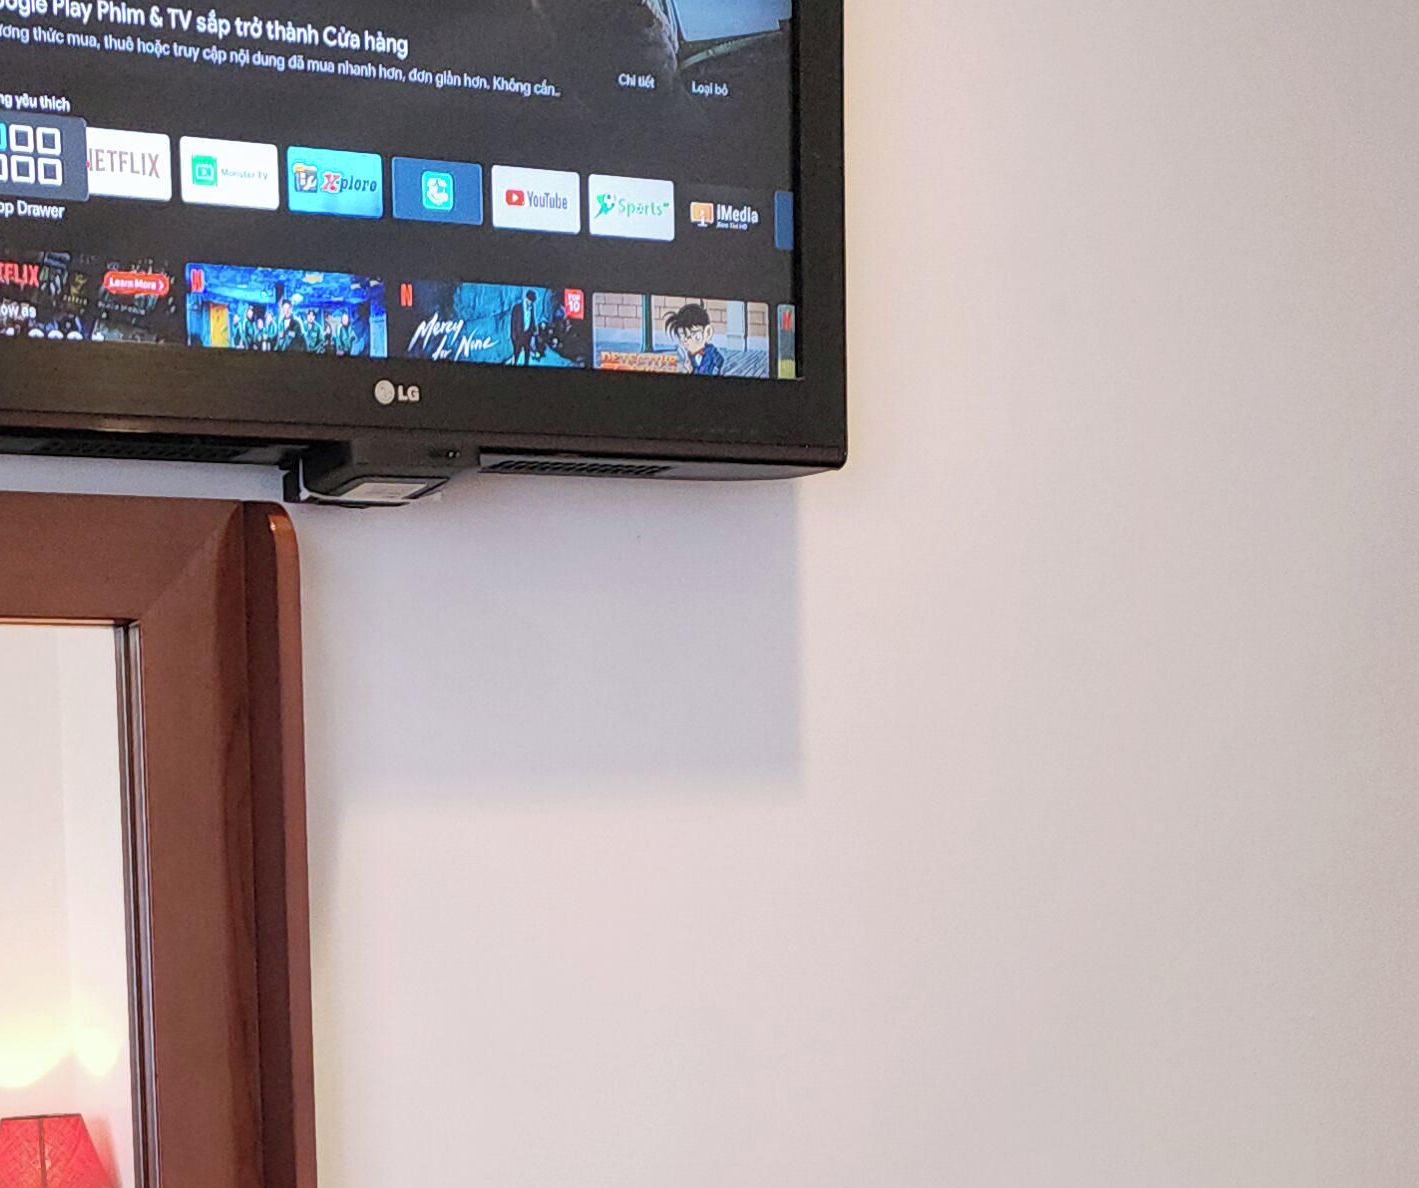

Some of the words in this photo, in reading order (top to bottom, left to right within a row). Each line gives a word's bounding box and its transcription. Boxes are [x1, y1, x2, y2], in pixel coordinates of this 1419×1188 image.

[52, 0, 93, 25] Play
[97, 0, 146, 26] Phim
[149, 5, 164, 28] &
[167, 7, 193, 31] TV
[195, 9, 231, 40] sắp
[322, 25, 361, 49] Cửa
[33, 26, 65, 44] thức
[67, 33, 101, 50] mua,
[103, 34, 134, 52] thuê
[137, 37, 171, 58] hoặc
[173, 42, 201, 62] truy
[202, 45, 227, 65] cập
[252, 50, 285, 72] dung
[288, 54, 305, 70] đã
[307, 58, 335, 73] mua
[338, 60, 377, 78] nhanh
[379, 64, 406, 83] hơn,
[408, 67, 432, 84] đơn
[493, 76, 531, 97] Không
[17, 200, 66, 220] Drawer
[527, 190, 568, 210] YouTube
[618, 198, 662, 218] Sports
[717, 203, 759, 224] iMedia
[109, 276, 133, 289] Learn
[21, 305, 37, 319] as
[568, 300, 580, 312] 10
[408, 311, 464, 351] Mercy
[397, 384, 420, 402] LG
